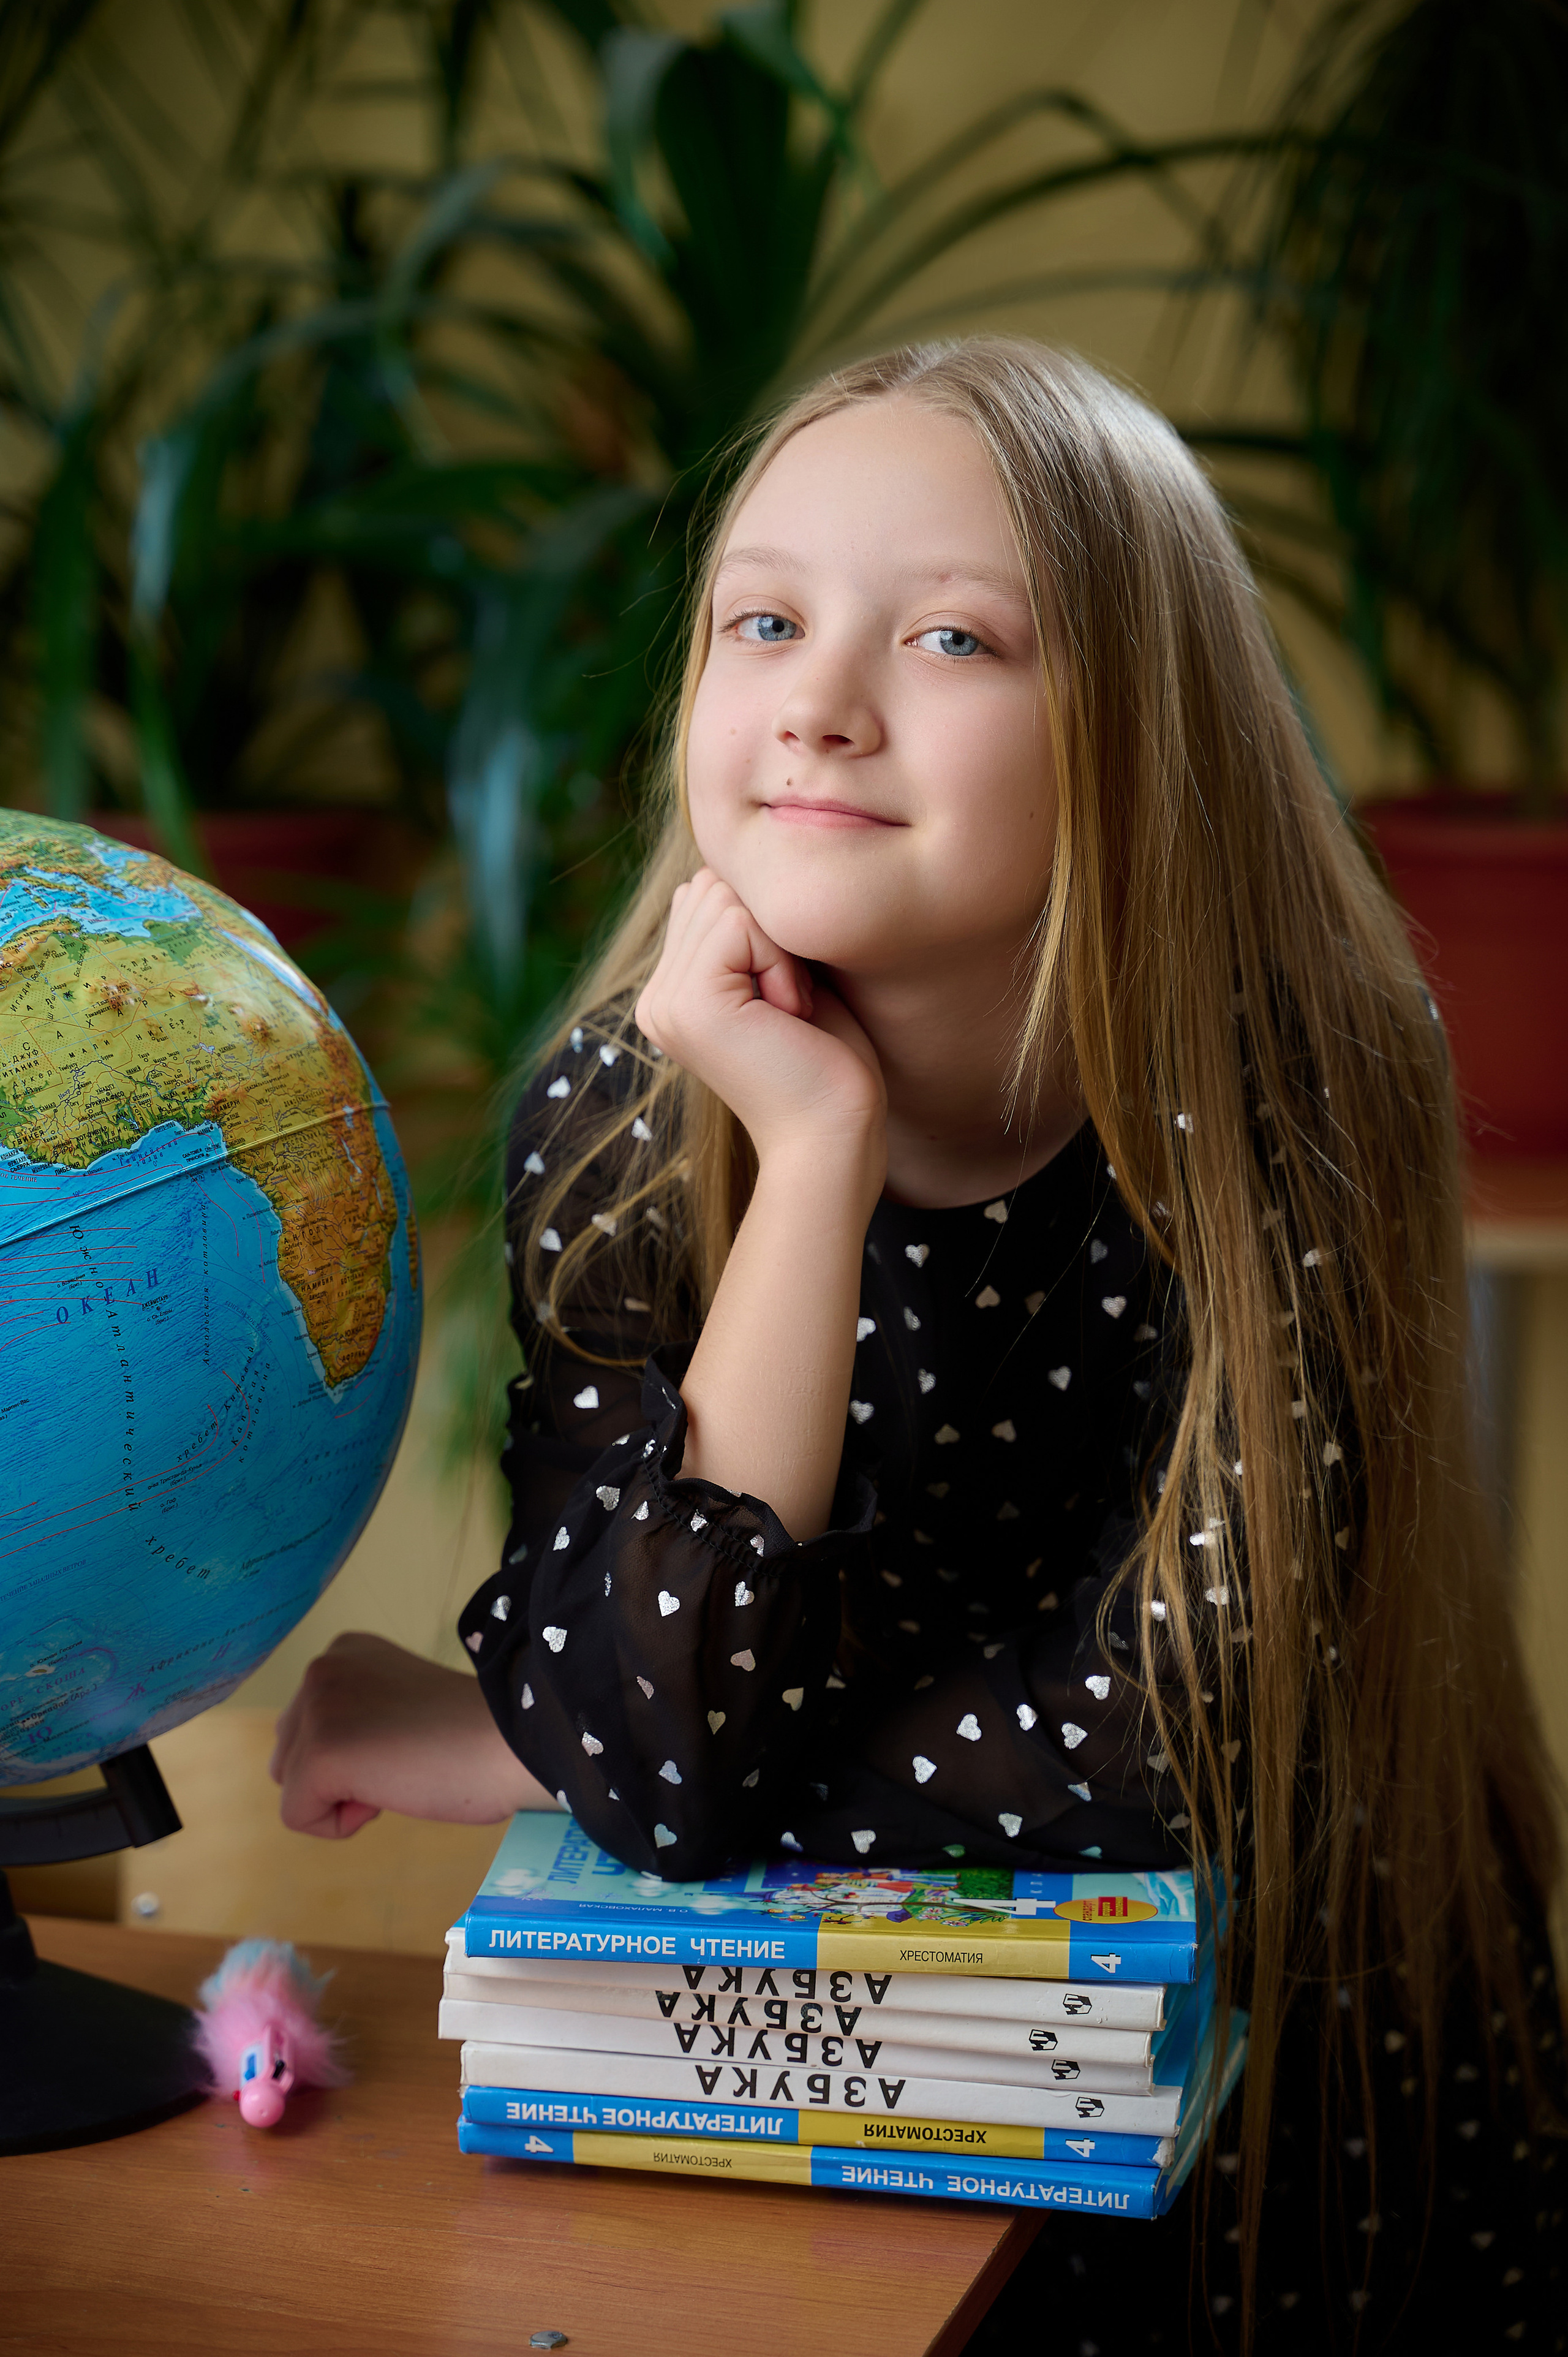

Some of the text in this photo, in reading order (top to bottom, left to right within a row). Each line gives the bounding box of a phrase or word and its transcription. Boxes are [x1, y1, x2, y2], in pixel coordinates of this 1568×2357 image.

[10, 982, 31, 1013] Игиди
[85, 1005, 111, 1019] Таманрассет
[136, 1019, 184, 1041] НИГЕР
[2, 1049, 39, 1067] ь-Джуф
[69, 1039, 110, 1059] МАЛИ
[2, 1059, 39, 1078] ИТАНИЯ
[58, 1063, 78, 1072] Томбукту
[13, 1070, 52, 1089] Аукер
[95, 1083, 116, 1095] УАГАДУГУ
[187, 1084, 201, 1094] Джос
[85, 1091, 124, 1109] БУРКИНА-ФАСО
[132, 1092, 149, 1102] БЕНИН
[39, 1102, 56, 1113] БАМАКО
[112, 1111, 129, 1121] ГАНА
[12, 1130, 45, 1148] ГВИНЕЯ
[0, 1149, 20, 1161] КОНАКРИ
[7, 1156, 27, 1168] ФРИТАУН
[10, 1155, 48, 1173] СЬЕРРА-ЛЕОНЕ
[31, 1162, 54, 1174] МОНРОВИЯ
[55, 1161, 81, 1176] ЛИБЕРИЯ
[201, 1204, 209, 1276] котловина
[284, 1224, 328, 1244] АНГОЛА
[69, 1281, 83, 1290] (Брит.)
[301, 1276, 334, 1292] НАМИБИЯ
[56, 1267, 160, 1324] ОКЕАН
[141, 1294, 169, 1311] ДЖЕЙМСТАУН
[155, 1317, 169, 1326] (Брит.)
[238, 1362, 270, 1464] котловина
[176, 1420, 219, 1462] хребет
[159, 1463, 203, 1485] Тристан-да-Кунья
[170, 1476, 186, 1487] (Брит.)
[161, 1502, 179, 1515] (Брит.)
[166, 1497, 177, 1507] Гоф
[145, 1535, 211, 1580] хребет
[28, 1570, 62, 1589] ЗАПАДНЫХ
[62, 1558, 87, 1575] ВЕТРОВ
[37, 1652, 58, 1665] Южная
[59, 1640, 83, 1654] Георгия
[48, 1654, 68, 1667] (Брит.)
[1, 1667, 85, 1712] ОРЕ СКОША
[579, 1903, 663, 1913] МАЛАХОВСКАЯ
[952, 1897, 1056, 1916] 4
[489, 1929, 785, 1960] ЛИТЕРАТУРНОЕ ЧТЕНИЕ
[899, 1949, 983, 1964] ХРЕСТОМАТИЯ
[1090, 1952, 1121, 1974] 4
[682, 1965, 892, 2005] АЗБУКА
[655, 1990, 862, 2037] АЗБУКА
[674, 2022, 883, 2069] АЗБУКА
[695, 2064, 907, 2109] АЗБУКА
[507, 2102, 783, 2135] ЛИТЕРАТУРНОЕ ЧТЕНИЕ
[864, 2124, 987, 2144] ХРЕСТОМАТИЯ
[524, 2135, 554, 2154] 4
[1065, 2137, 1096, 2158] 4
[653, 2152, 733, 2169] ХРЕСТОМАТИЯ
[841, 2165, 1131, 2211] ЛИТЕРАТУРНОЕ ЧТЕНИЕ
